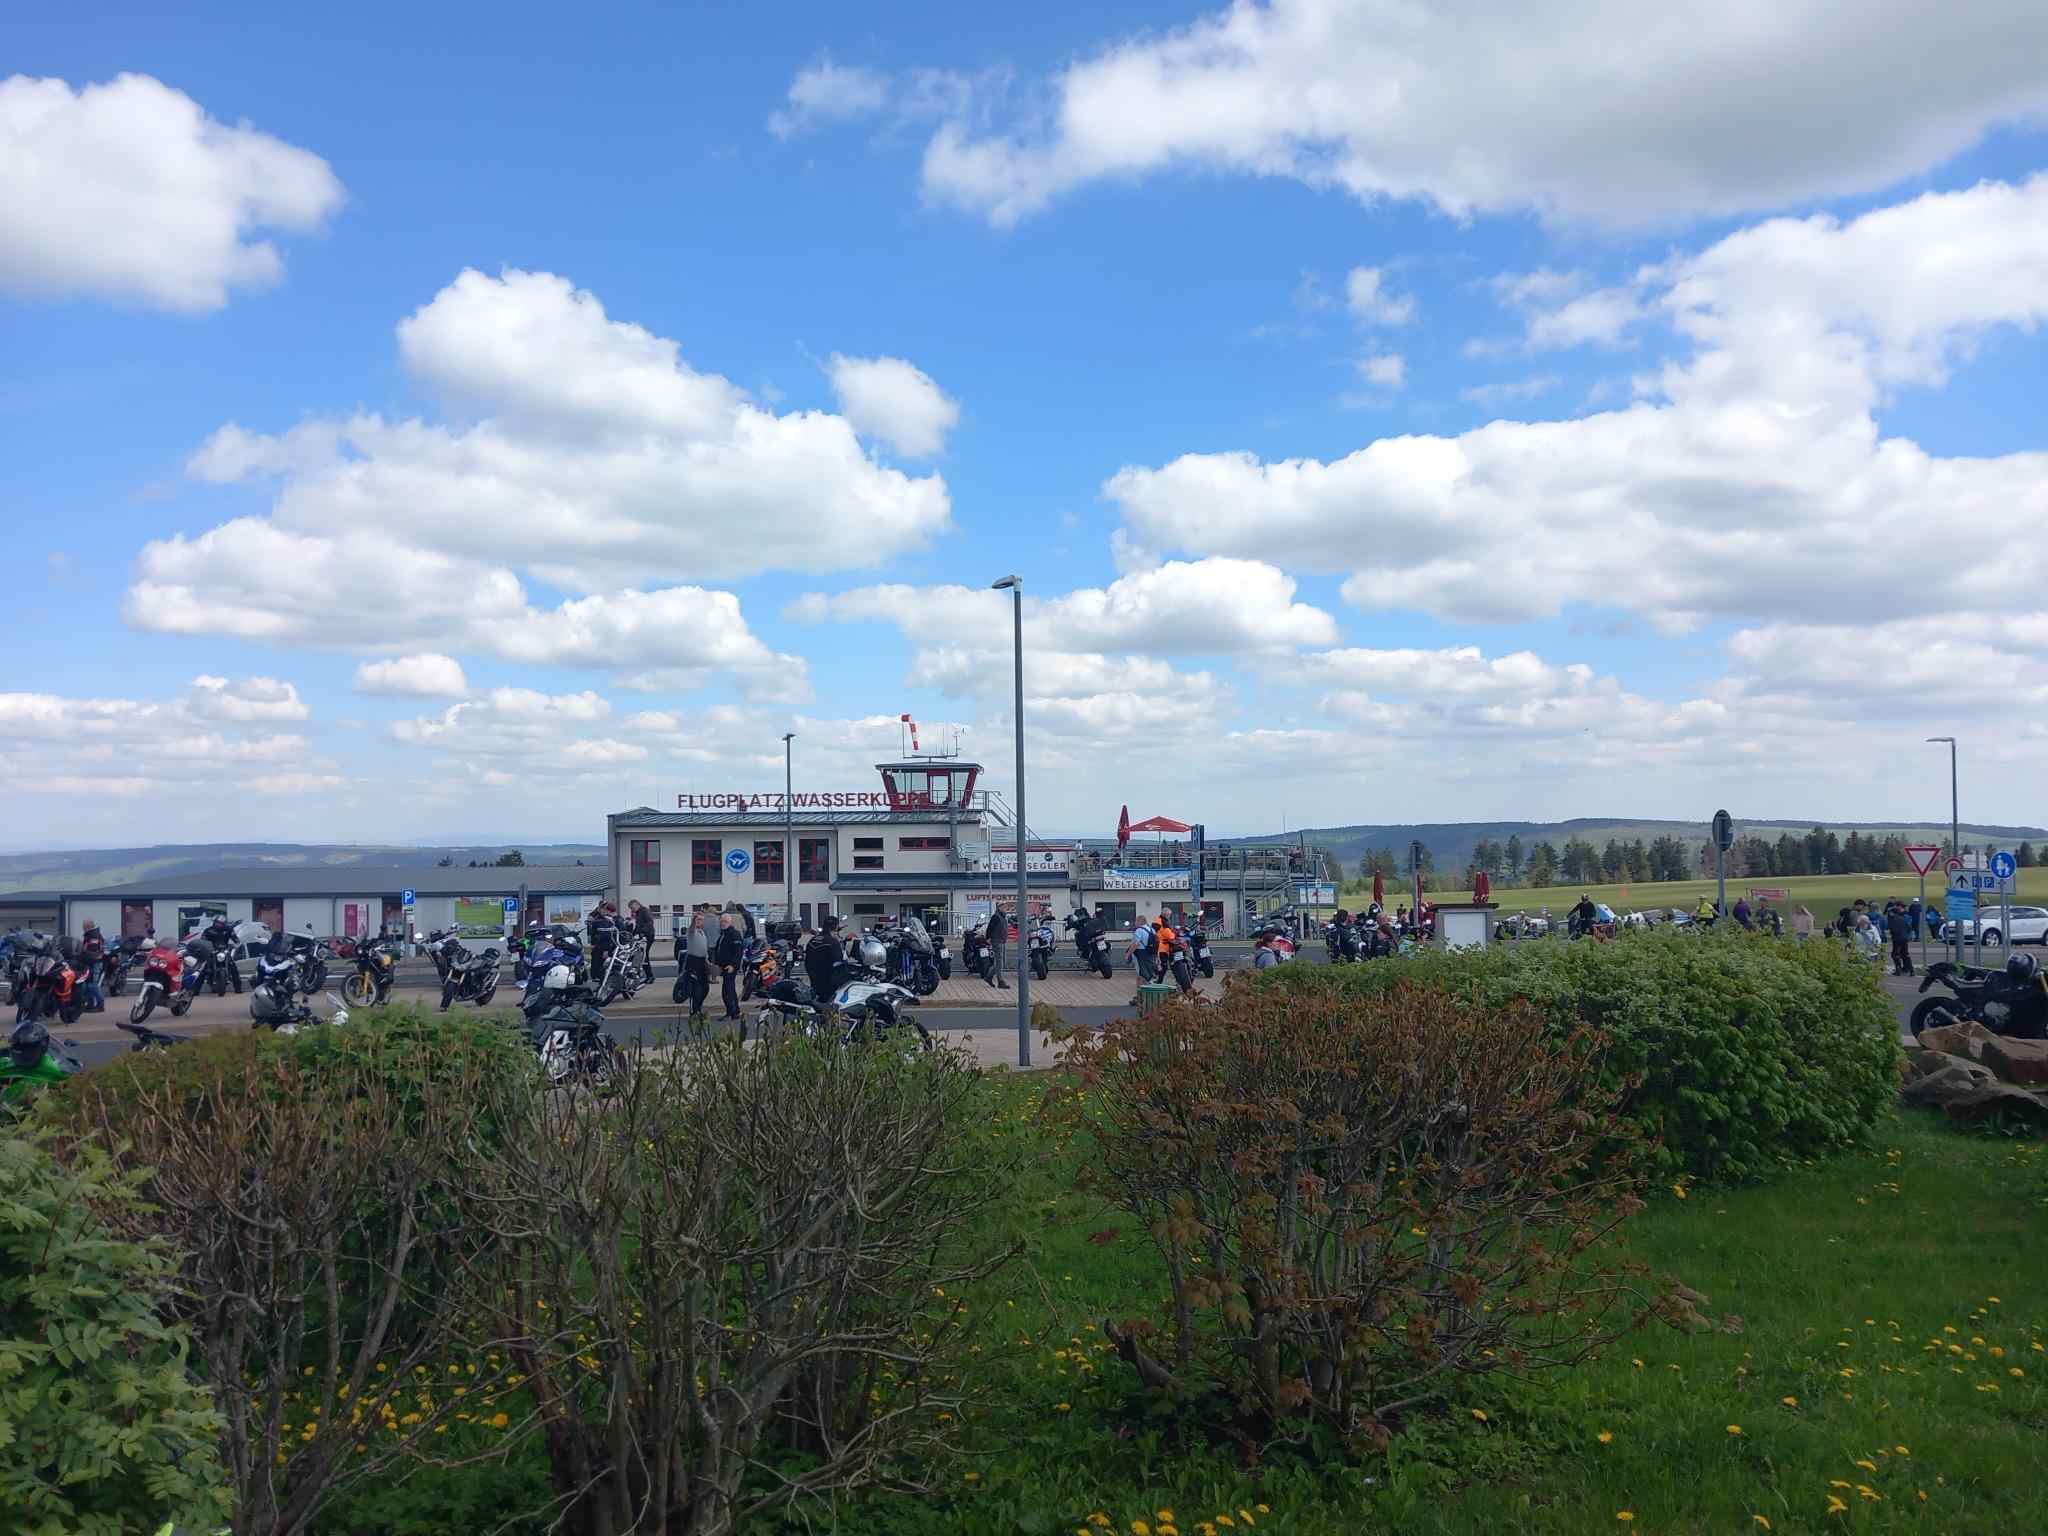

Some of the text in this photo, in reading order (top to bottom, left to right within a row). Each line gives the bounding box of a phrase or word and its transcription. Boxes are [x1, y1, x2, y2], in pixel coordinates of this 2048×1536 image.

[678, 794, 784, 808] FLUGPLATZ
[982, 862, 1066, 870] WELTESEGLER
[1104, 880, 1188, 889] WELTENSEGLER
[405, 891, 412, 904] P
[506, 900, 515, 910] P
